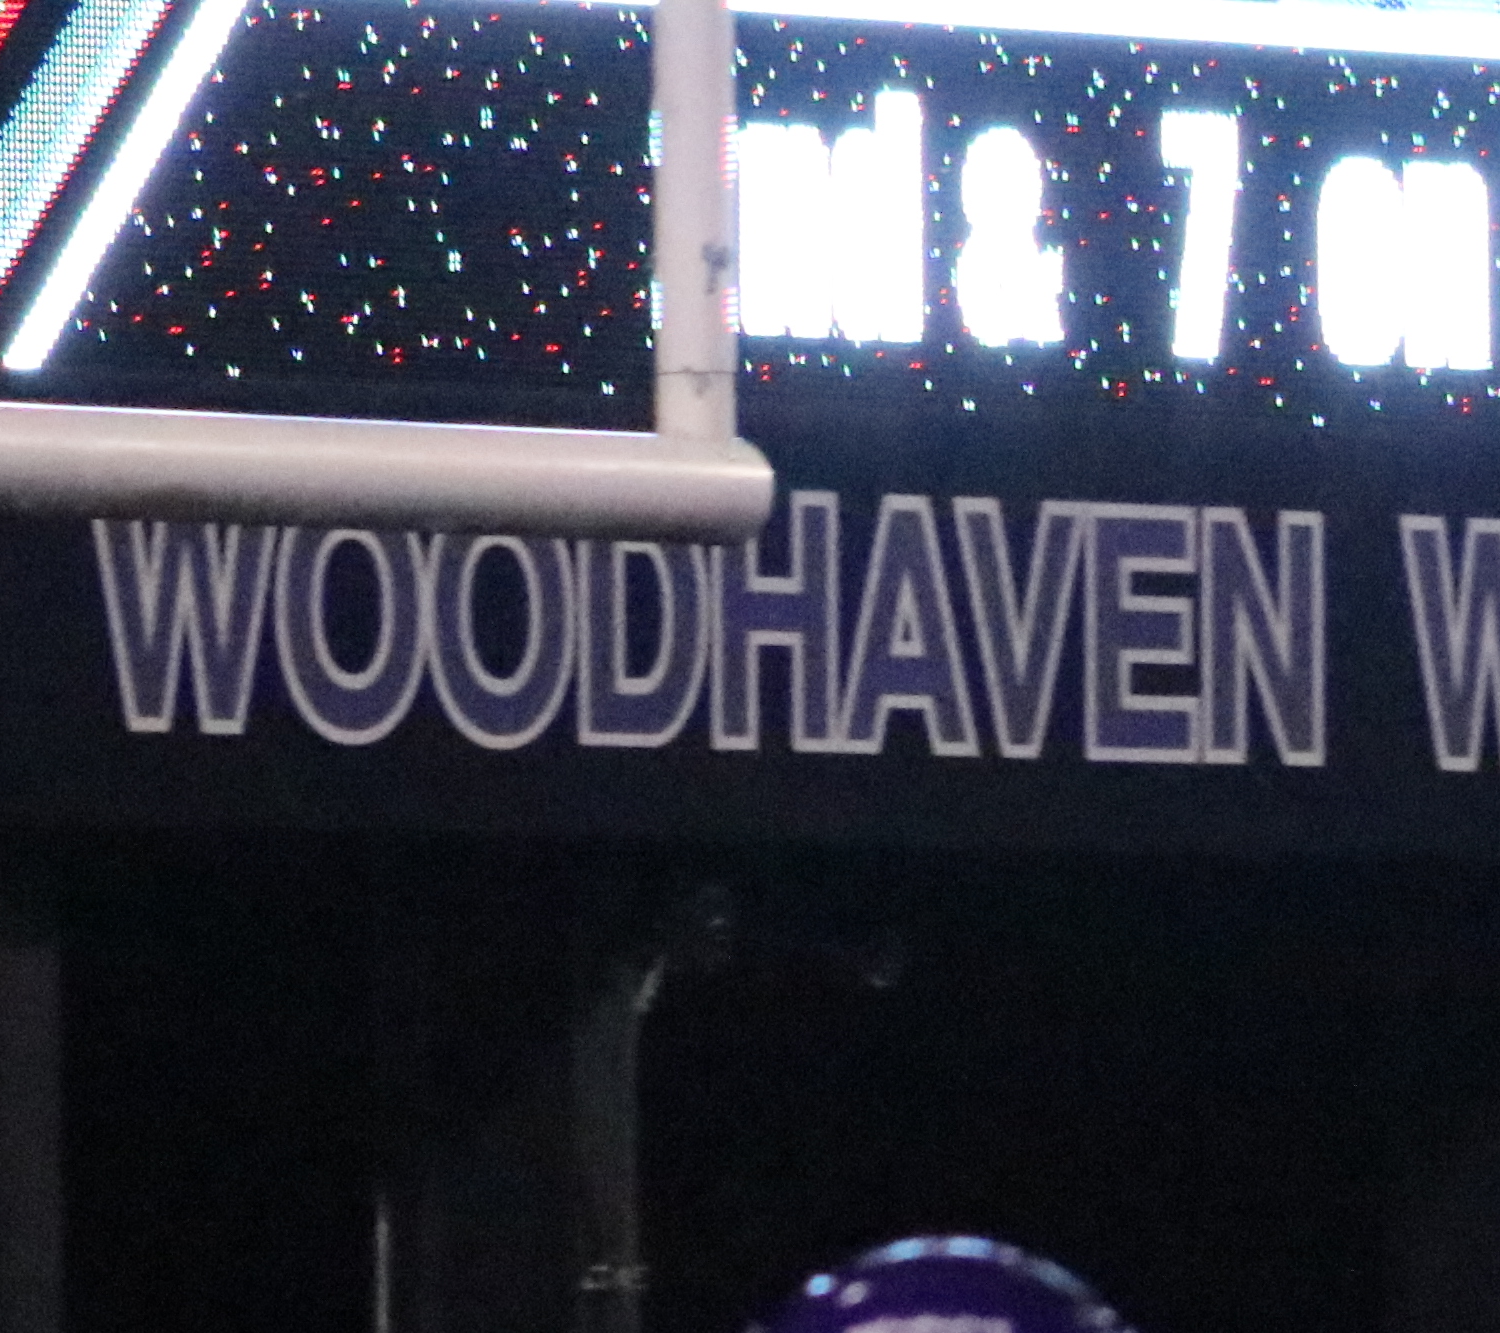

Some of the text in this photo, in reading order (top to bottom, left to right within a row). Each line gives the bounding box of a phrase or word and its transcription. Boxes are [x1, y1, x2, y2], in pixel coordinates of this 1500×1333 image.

[726, 91, 924, 343] nd
[957, 126, 1063, 346] &
[1160, 111, 1240, 360] 7
[1316, 156, 1491, 370] on
[91, 489, 1327, 767] WOODHAVEN
